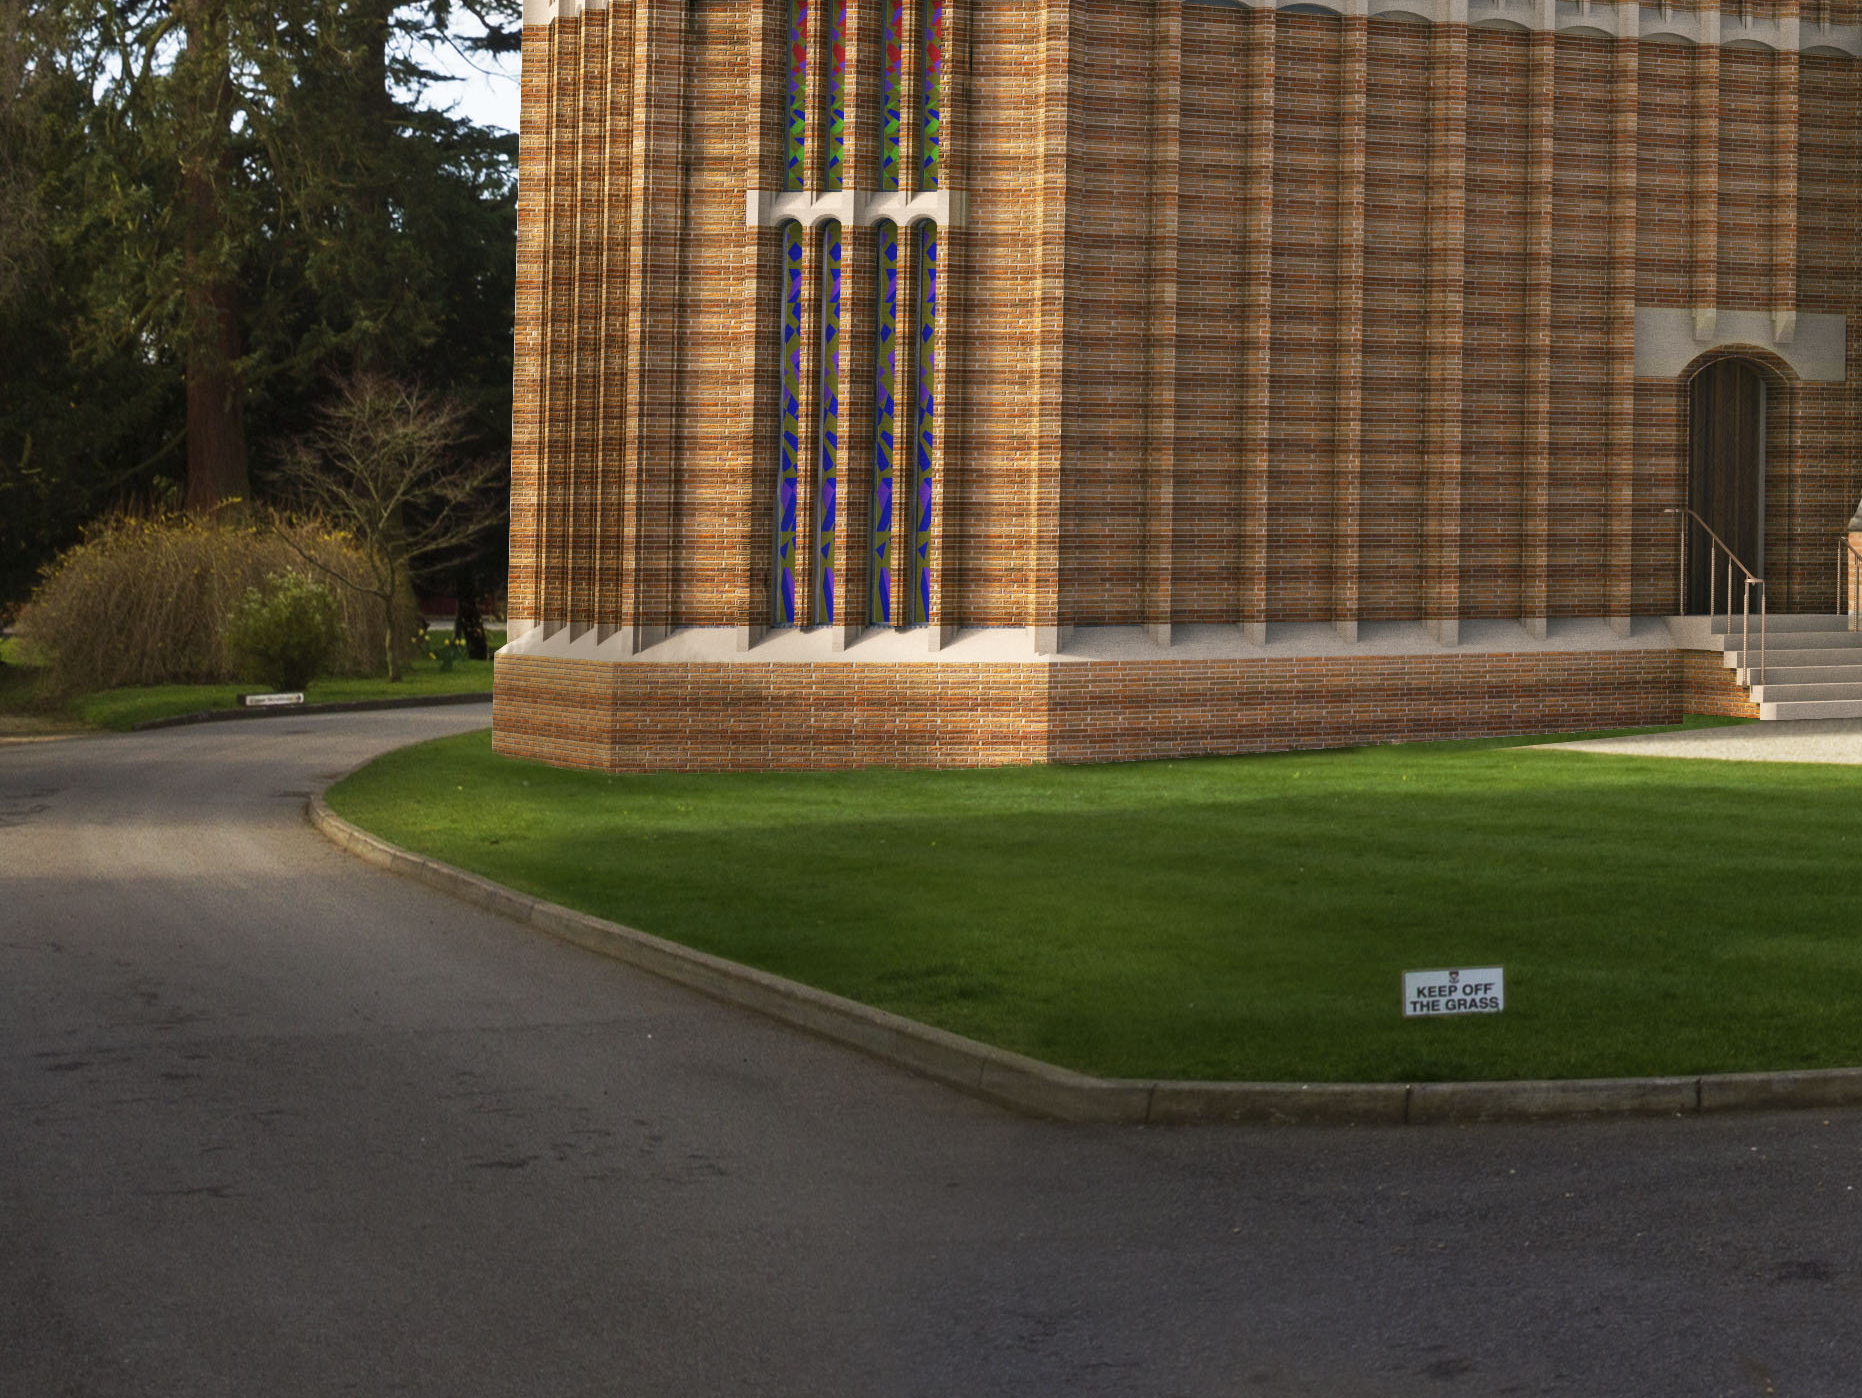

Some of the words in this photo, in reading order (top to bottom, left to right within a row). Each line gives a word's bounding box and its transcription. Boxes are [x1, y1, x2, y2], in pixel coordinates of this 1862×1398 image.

[1417, 985, 1458, 998] KEEP
[1462, 982, 1495, 996] OFF
[1410, 999, 1441, 1012] THE
[1445, 997, 1500, 1011] GRASS
